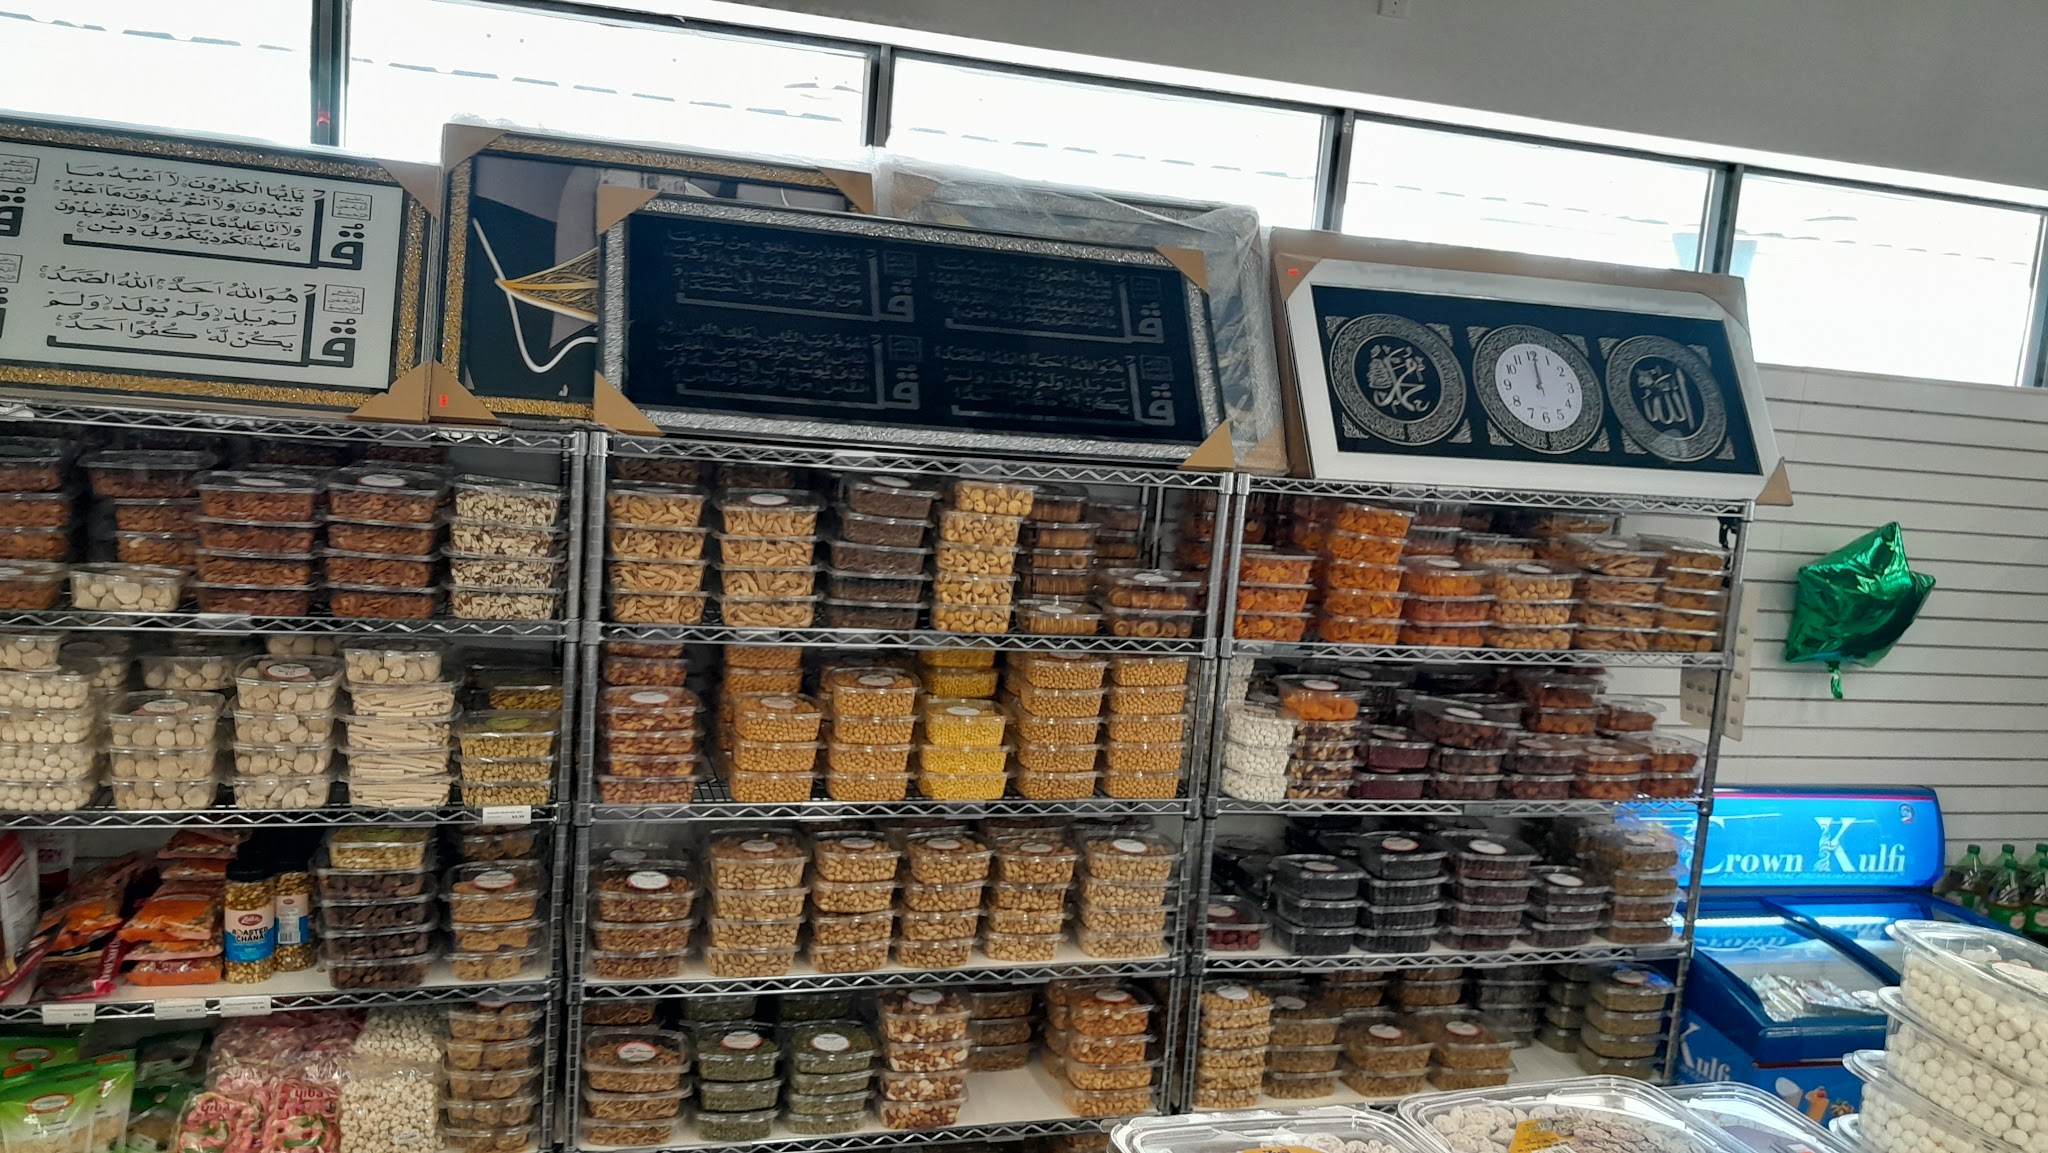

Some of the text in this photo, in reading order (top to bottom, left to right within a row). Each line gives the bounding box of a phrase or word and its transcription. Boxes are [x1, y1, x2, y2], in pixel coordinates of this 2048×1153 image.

[1513, 354, 1522, 366] 11
[1526, 350, 1539, 362] 12
[1545, 355, 1551, 367] 1
[1506, 364, 1517, 374] 10
[1556, 366, 1566, 378] 2
[1503, 379, 1512, 391] 9
[1566, 382, 1574, 394] 3
[1512, 395, 1521, 407] 8
[1565, 398, 1572, 409] 4
[1527, 407, 1535, 419] 7
[1542, 411, 1551, 423] 6
[1556, 409, 1564, 421] 5
[1814, 816, 1907, 874] Kulfi
[236, 934, 265, 942] CHANA
